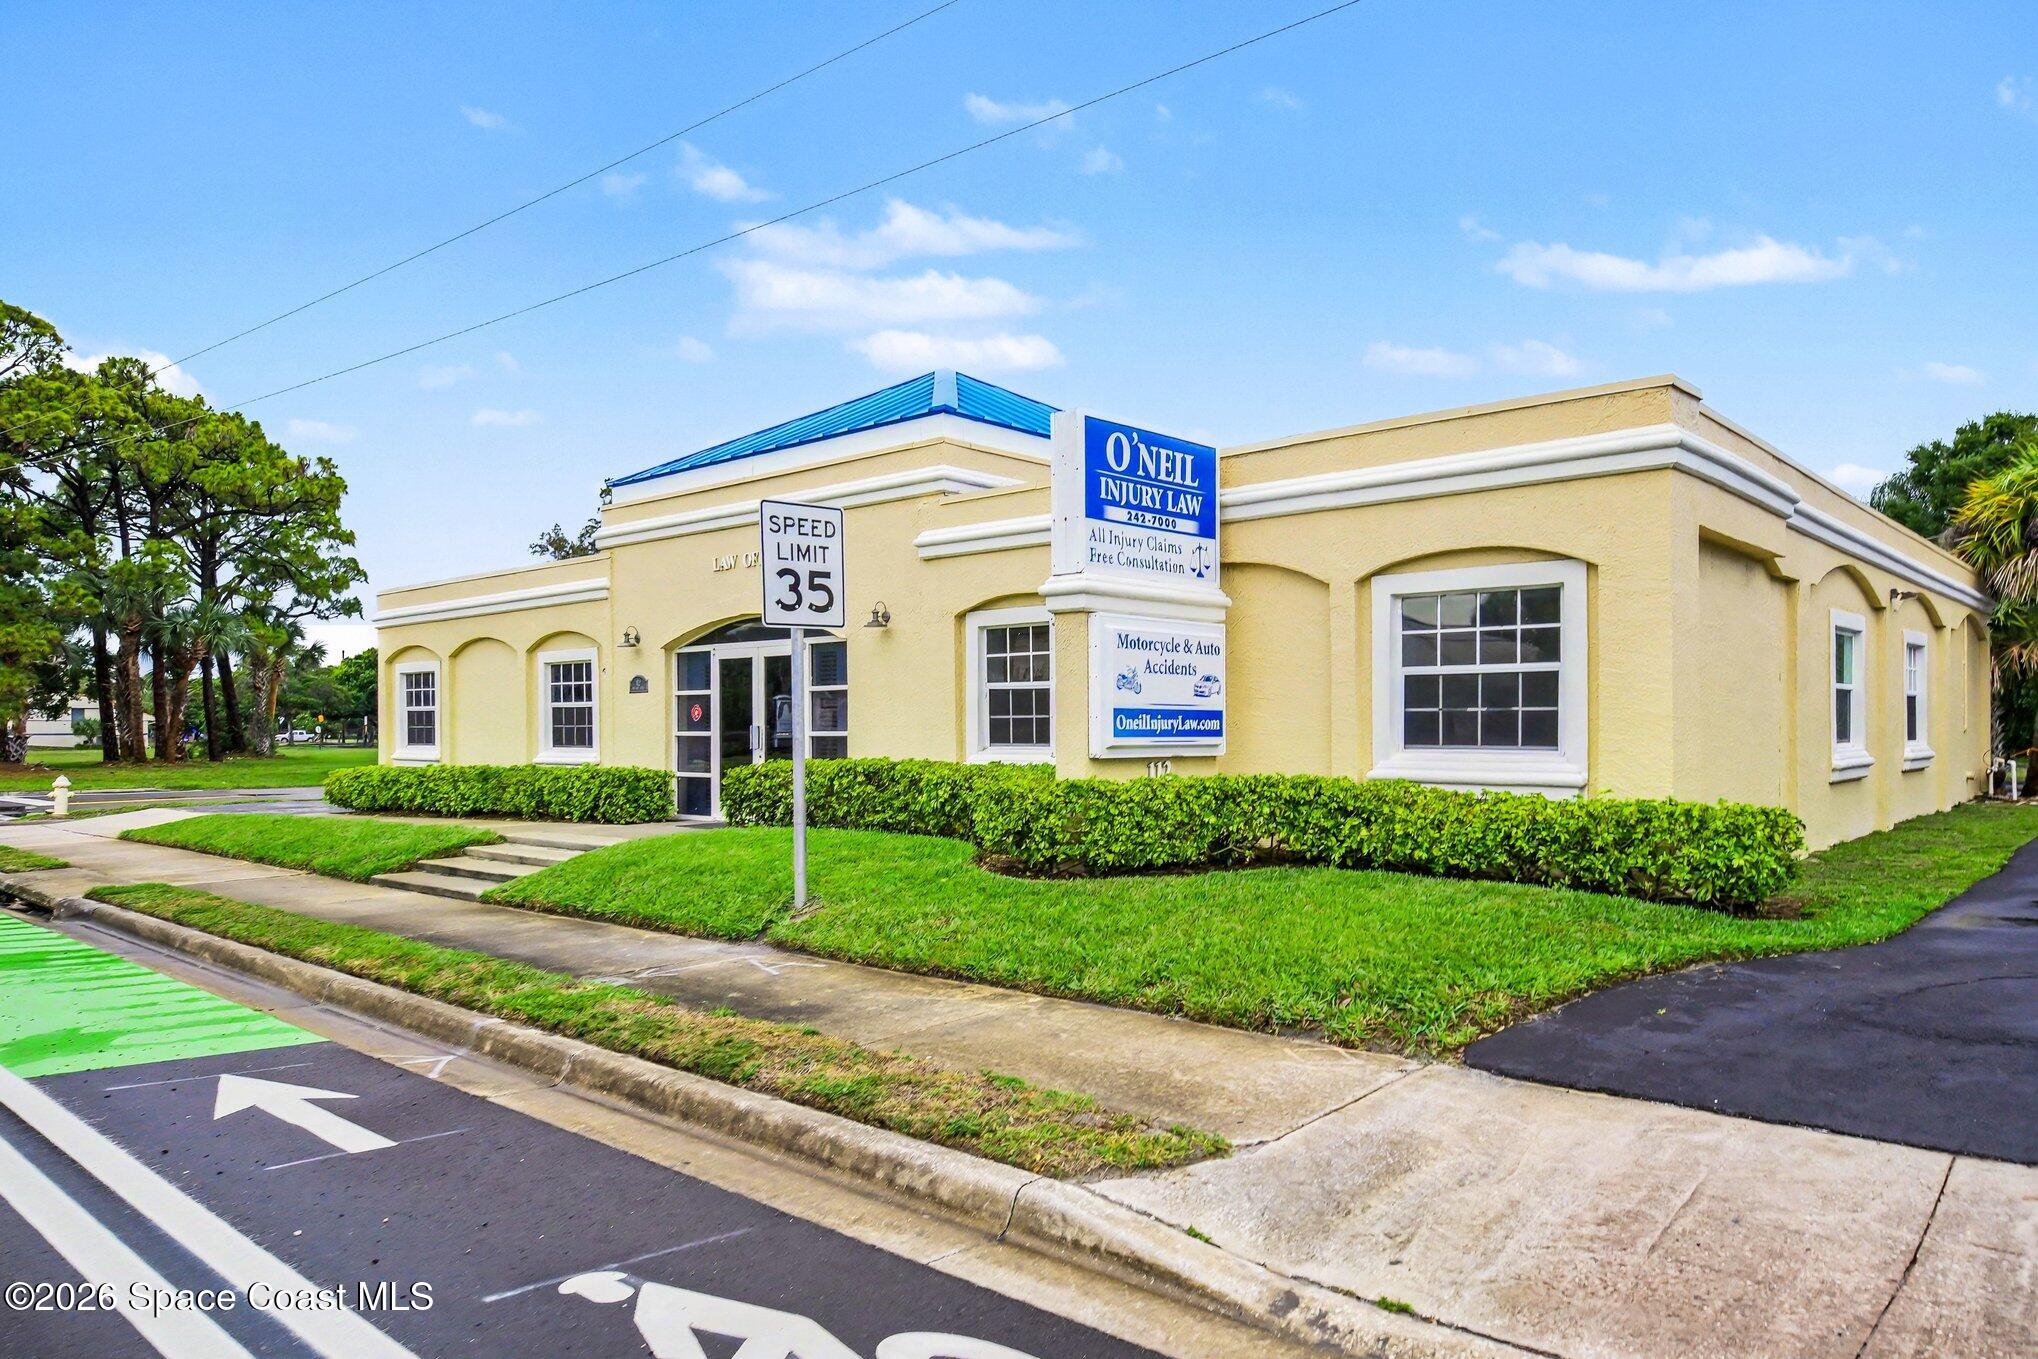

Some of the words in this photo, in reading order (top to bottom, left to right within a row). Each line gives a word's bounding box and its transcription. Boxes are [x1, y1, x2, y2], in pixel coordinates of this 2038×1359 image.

[1106, 431, 1199, 487] O'NEIL
[1099, 476, 1164, 510] INJURY
[1166, 490, 1203, 517] LAW
[769, 514, 836, 538] SPEED
[776, 541, 830, 564] LIMIT
[1089, 526, 1105, 544] All
[1109, 530, 1144, 553] Injury
[1146, 535, 1182, 555] Claims
[713, 554, 738, 572] LAW
[743, 551, 761, 569] OF
[1089, 547, 1113, 565] Free
[1117, 551, 1185, 574] Consultation
[775, 567, 834, 613] 35
[1116, 632, 1181, 656] Motorcycle
[1183, 638, 1193, 655] &
[1195, 640, 1221, 656] Auto
[1144, 659, 1197, 676] Accidents
[1116, 714, 1220, 734] OneilInjuryLaw.com
